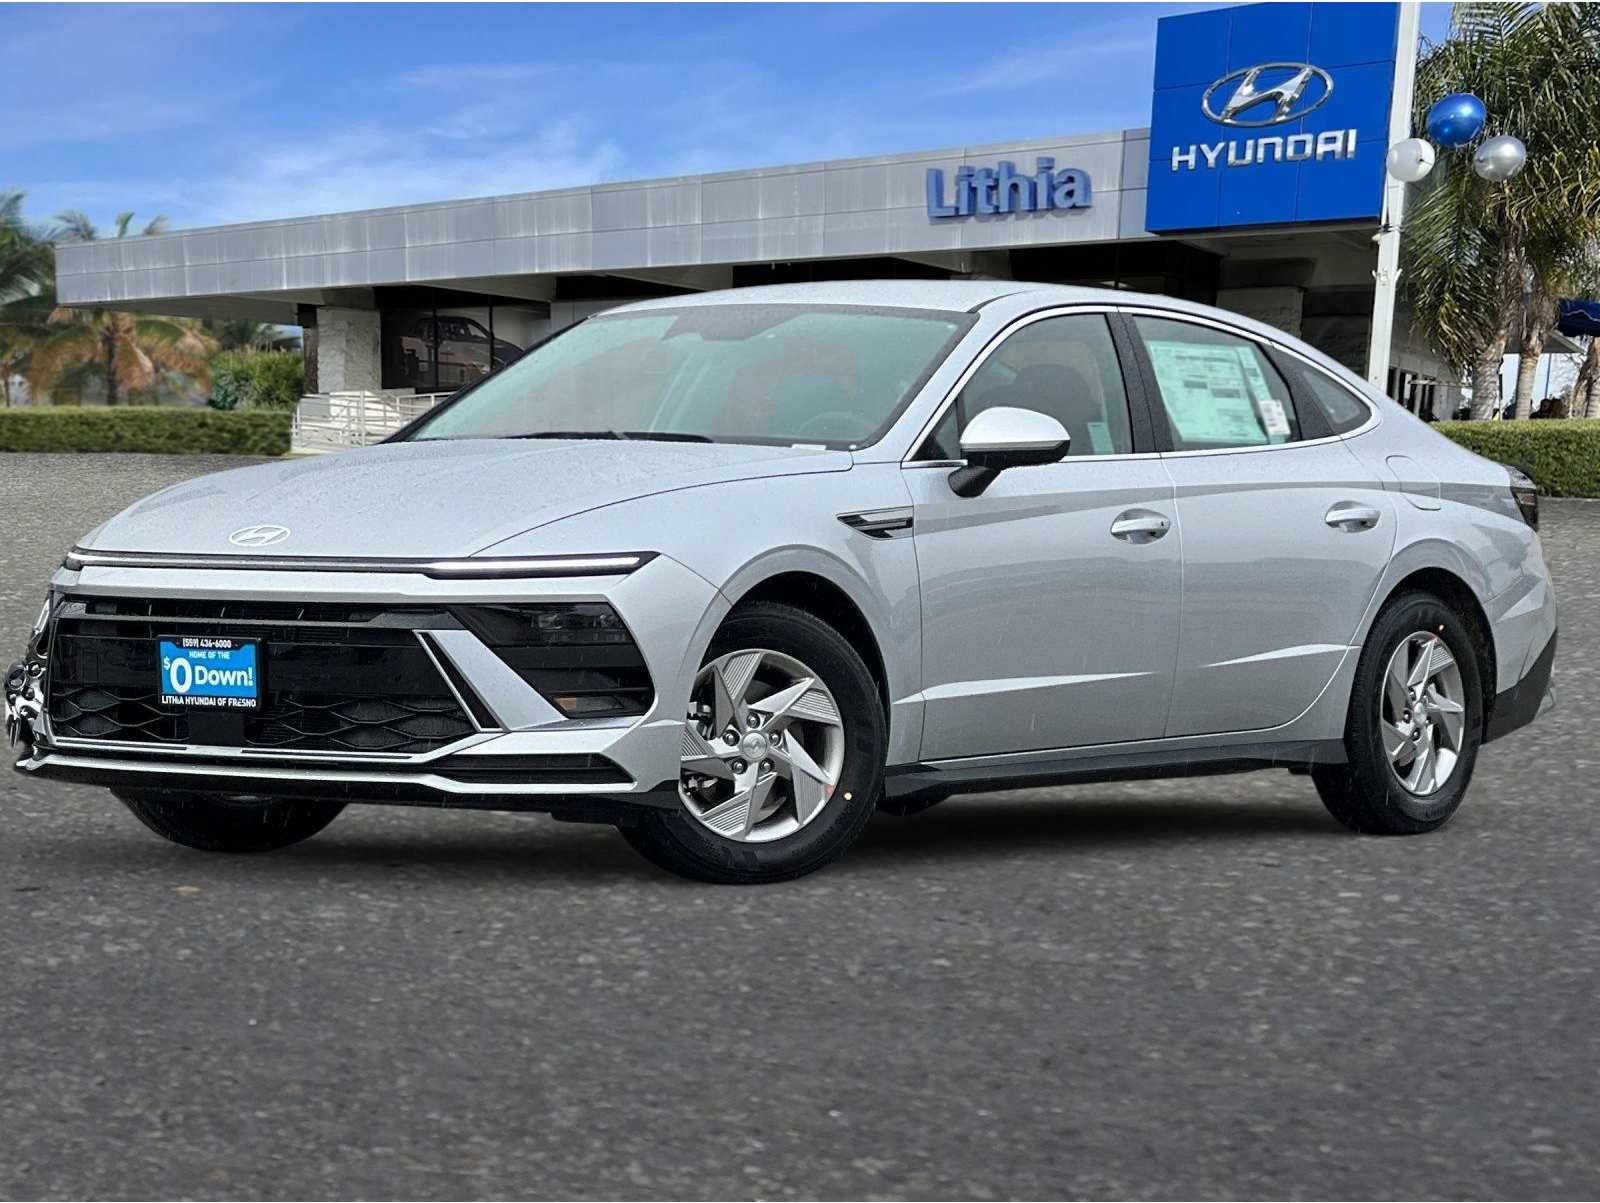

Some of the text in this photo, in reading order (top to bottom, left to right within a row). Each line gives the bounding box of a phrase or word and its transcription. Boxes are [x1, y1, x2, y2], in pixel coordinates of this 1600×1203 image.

[1171, 128, 1357, 171] HYUNDAI
[926, 157, 1092, 219] Lithia
[200, 639, 231, 648] 436-6000
[189, 651, 231, 659] HOME OF THE
[195, 665, 254, 686] Down!
[162, 696, 256, 707] LITHIA HYUNDAI OF FRESNO
